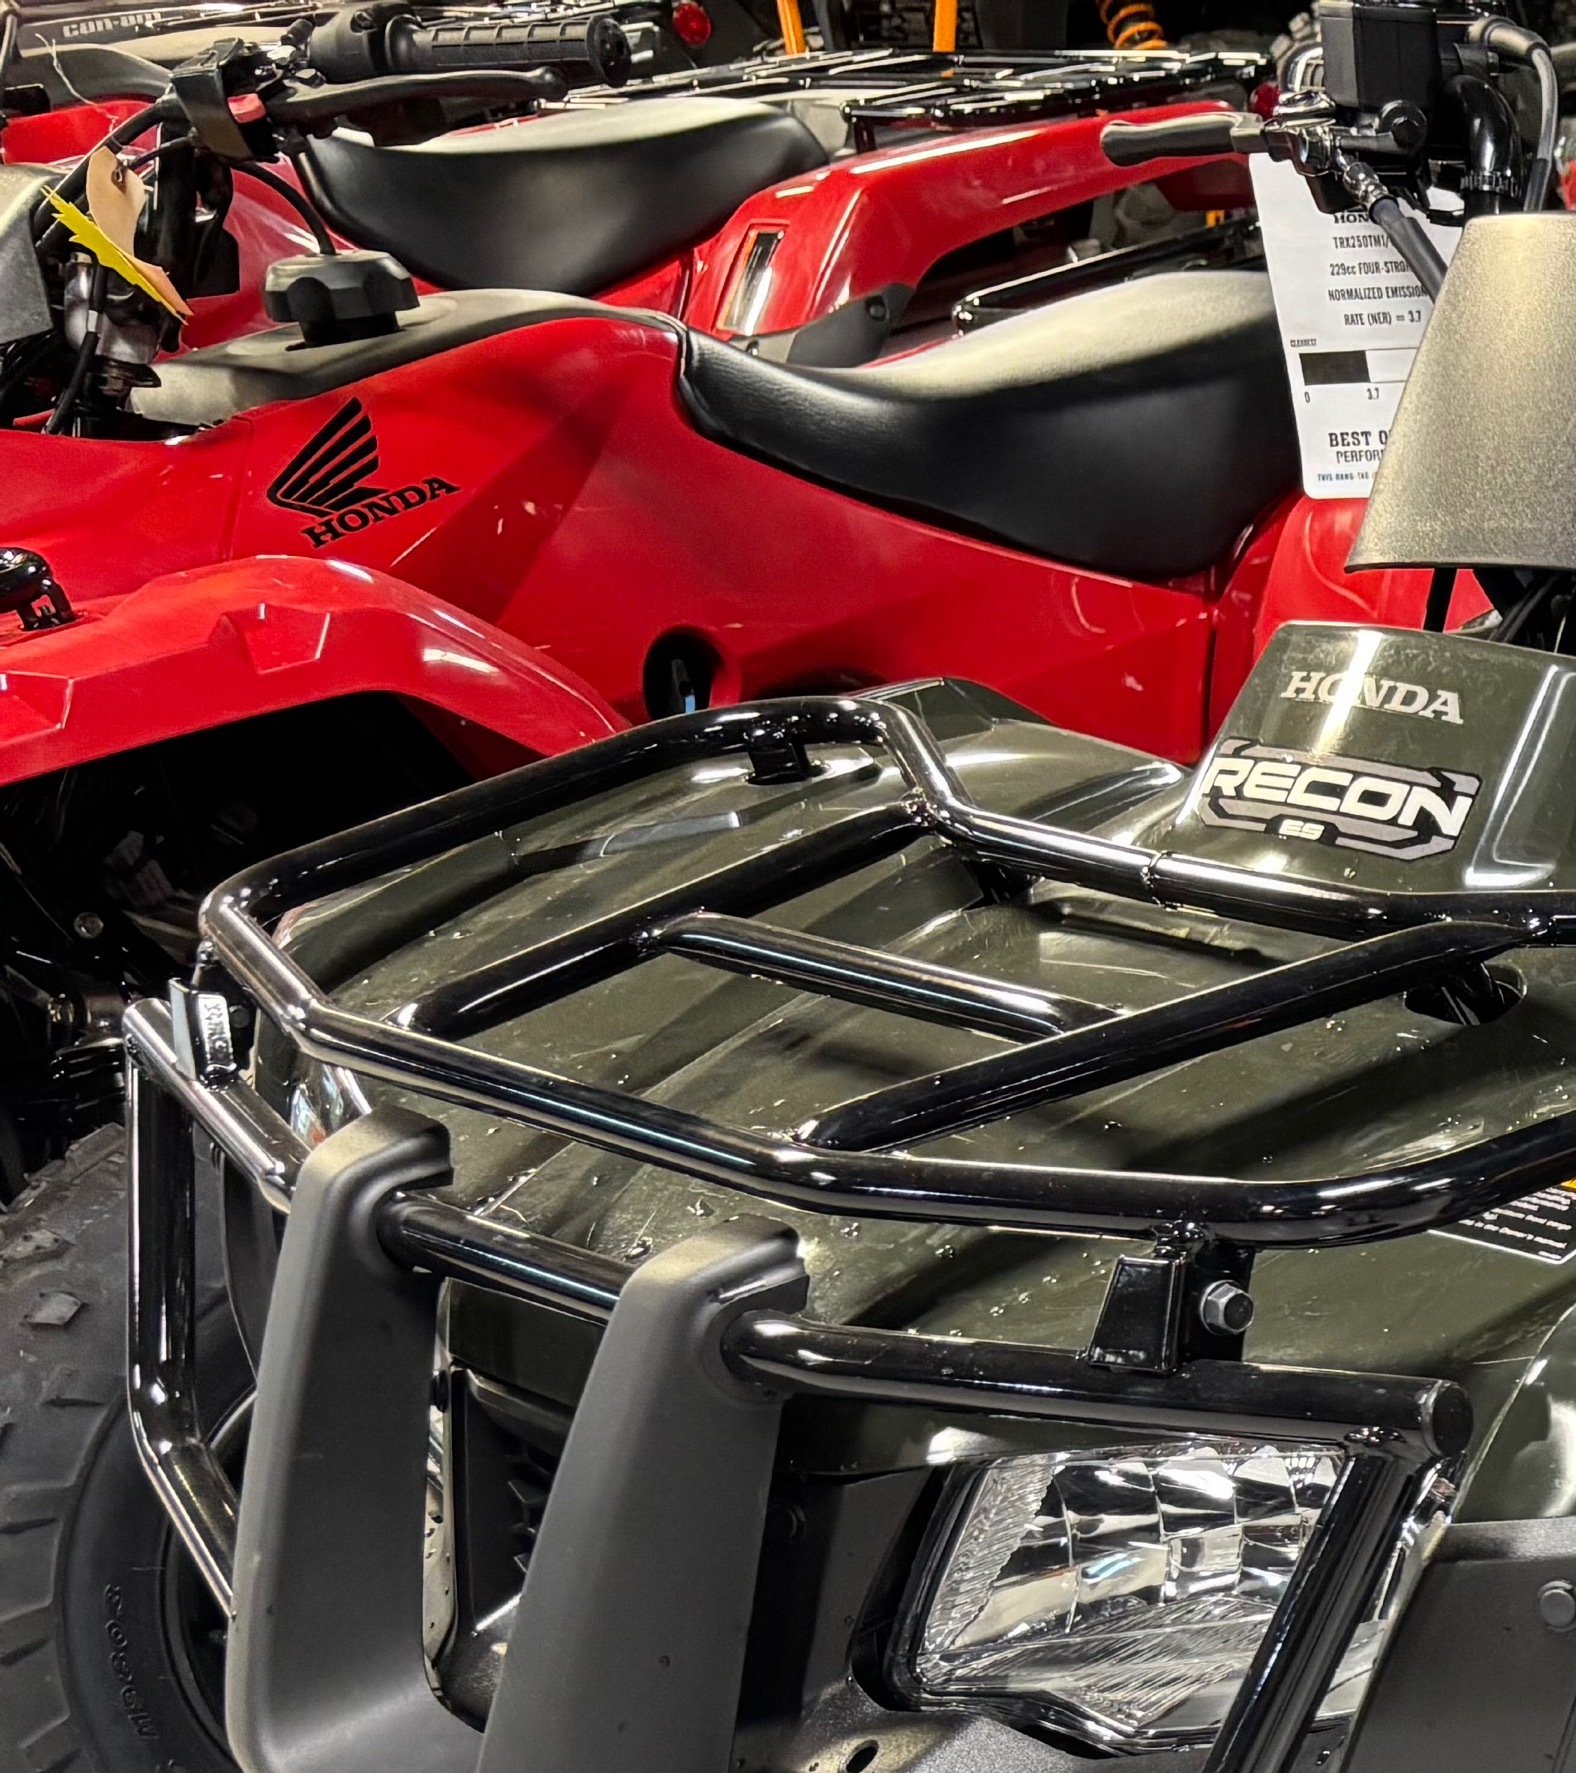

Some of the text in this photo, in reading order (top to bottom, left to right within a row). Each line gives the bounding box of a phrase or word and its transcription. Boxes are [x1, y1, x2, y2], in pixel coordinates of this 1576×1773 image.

[1330, 261, 1413, 276] 229cc FOUR-STRO
[1328, 287, 1383, 301] NORMALIZED
[1344, 313, 1365, 326] RATE
[1367, 311, 1392, 326] (NER)
[1408, 310, 1422, 323] 3.7
[1304, 391, 1311, 403] 0
[1366, 387, 1380, 400] 3.7
[1328, 430, 1391, 447] BEST O
[301, 477, 461, 548] HONDA
[1281, 671, 1464, 724] HONDA
[1202, 757, 1473, 837] RECON
[1279, 819, 1325, 840] ES
